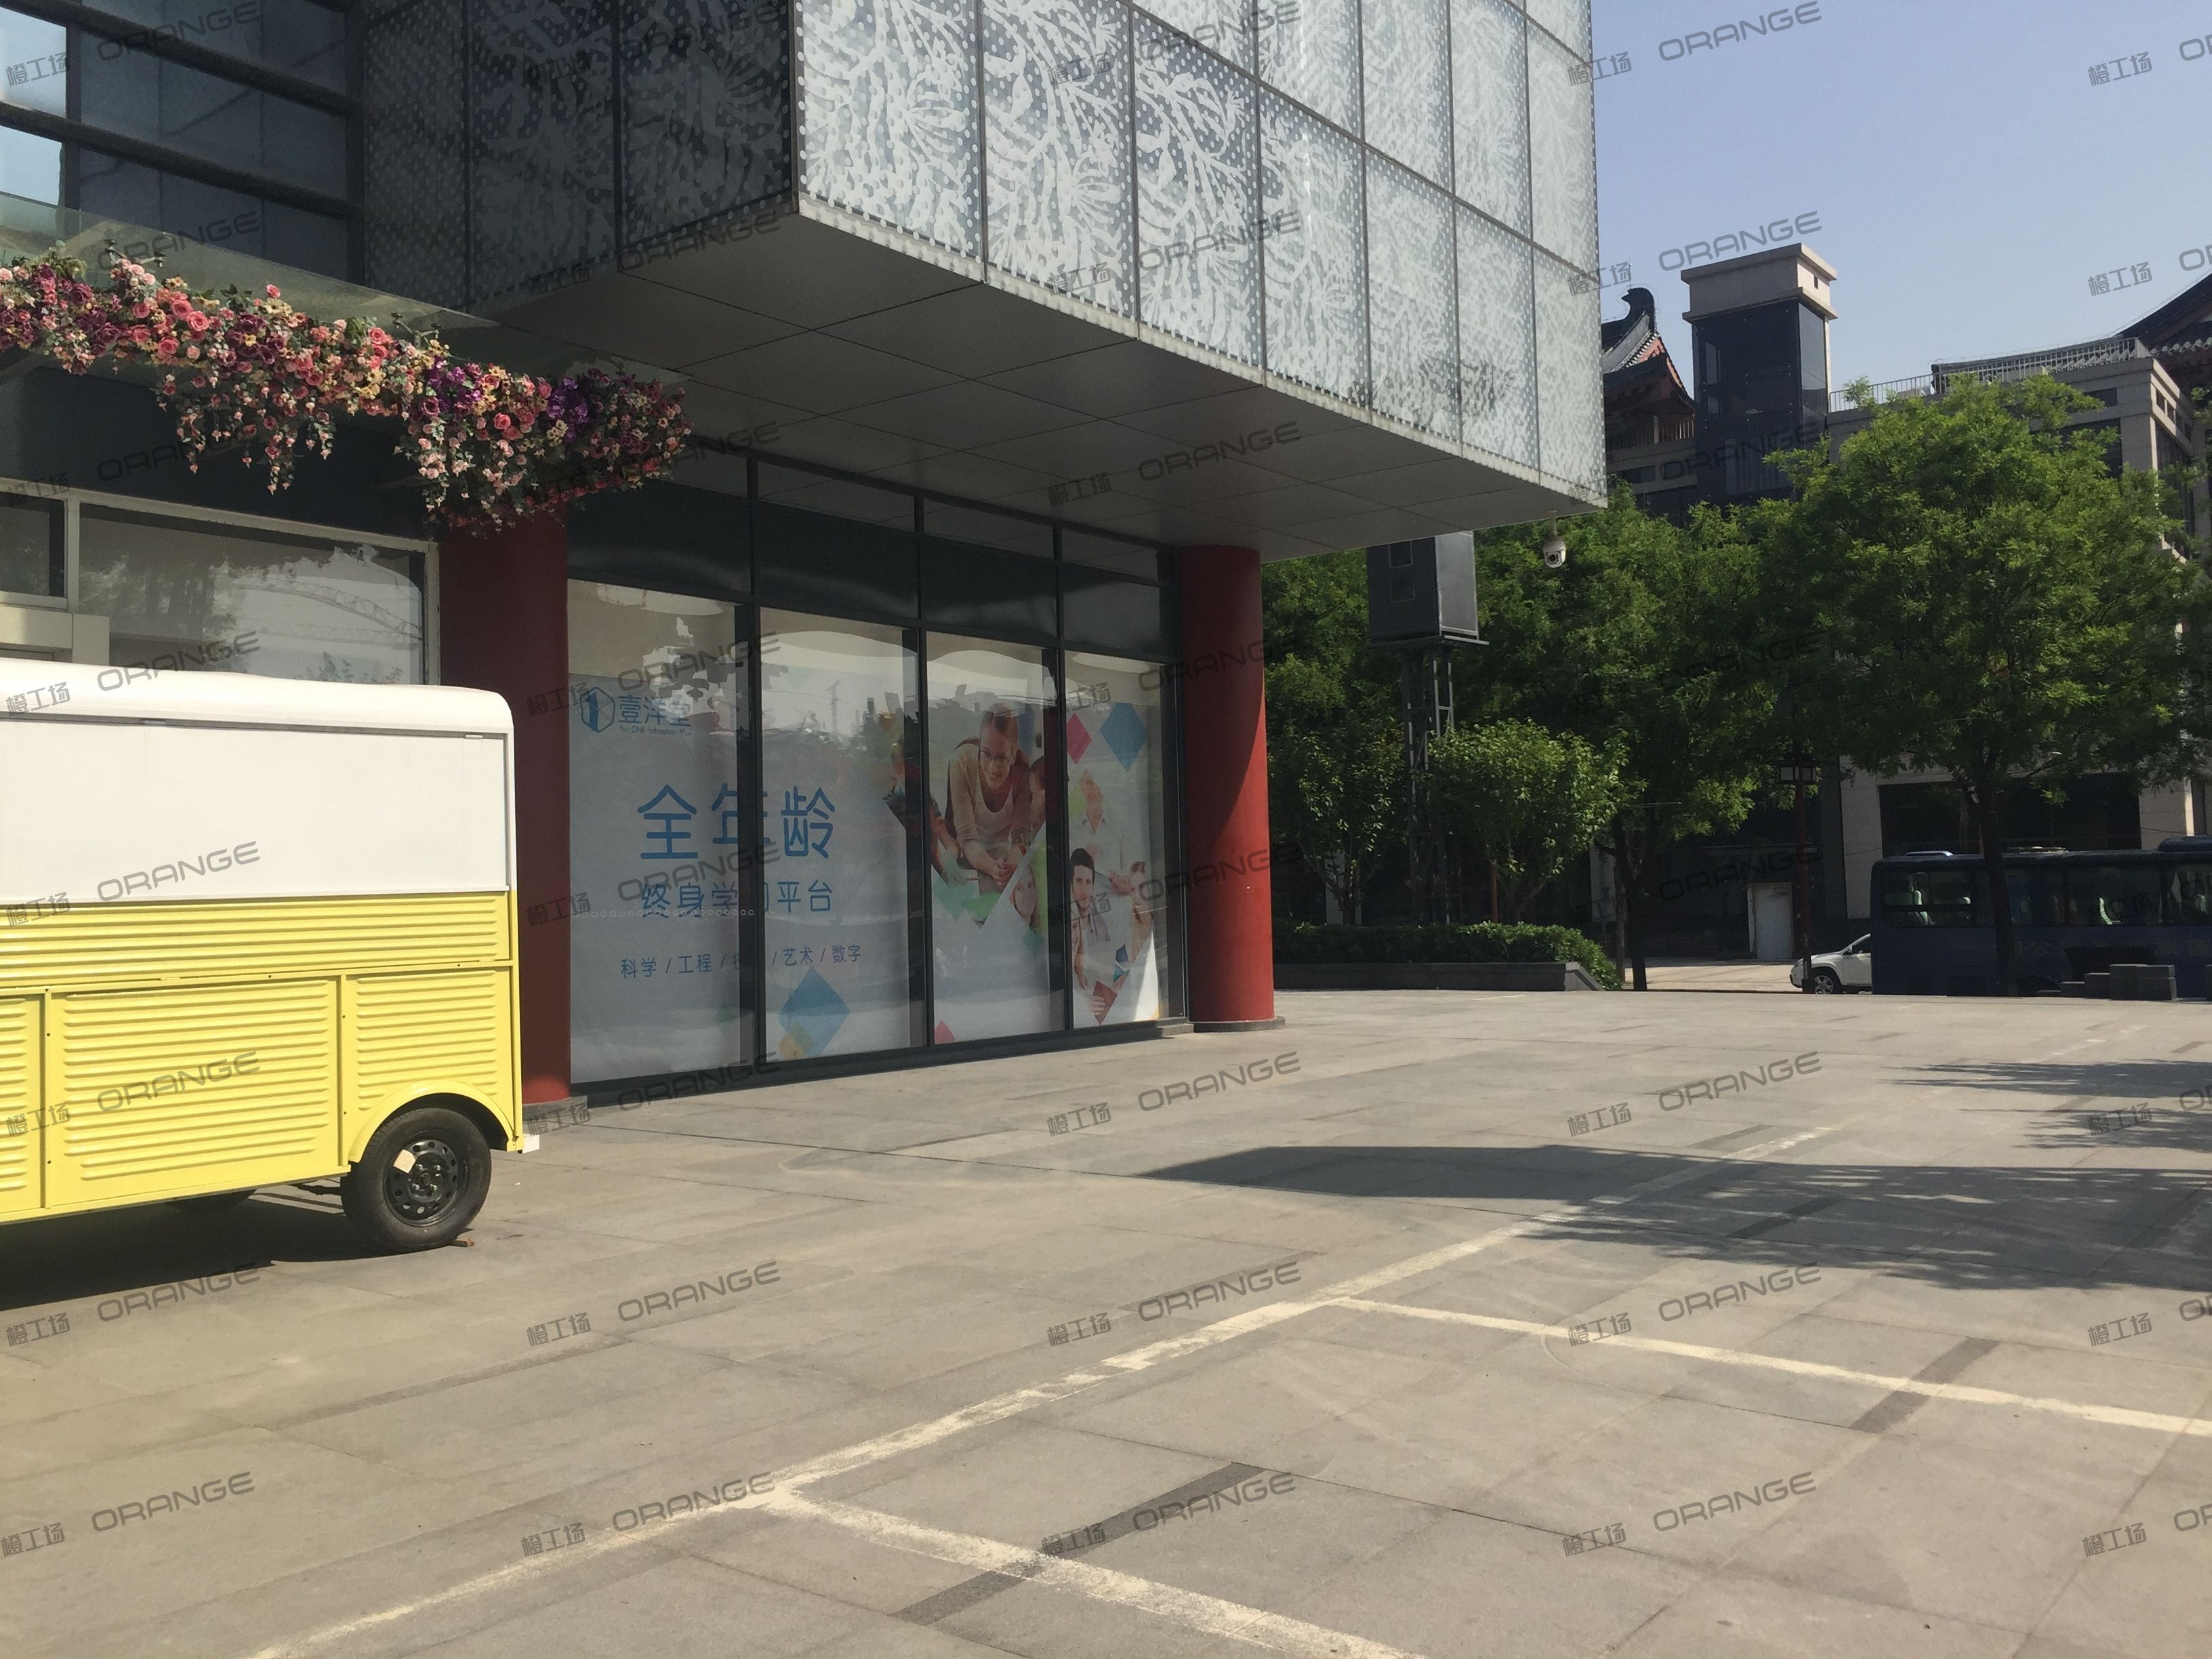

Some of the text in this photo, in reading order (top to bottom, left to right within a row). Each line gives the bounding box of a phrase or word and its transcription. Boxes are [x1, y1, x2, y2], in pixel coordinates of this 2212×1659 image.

[638, 783, 835, 859] 全年龄
[641, 880, 832, 918] 终身学平台
